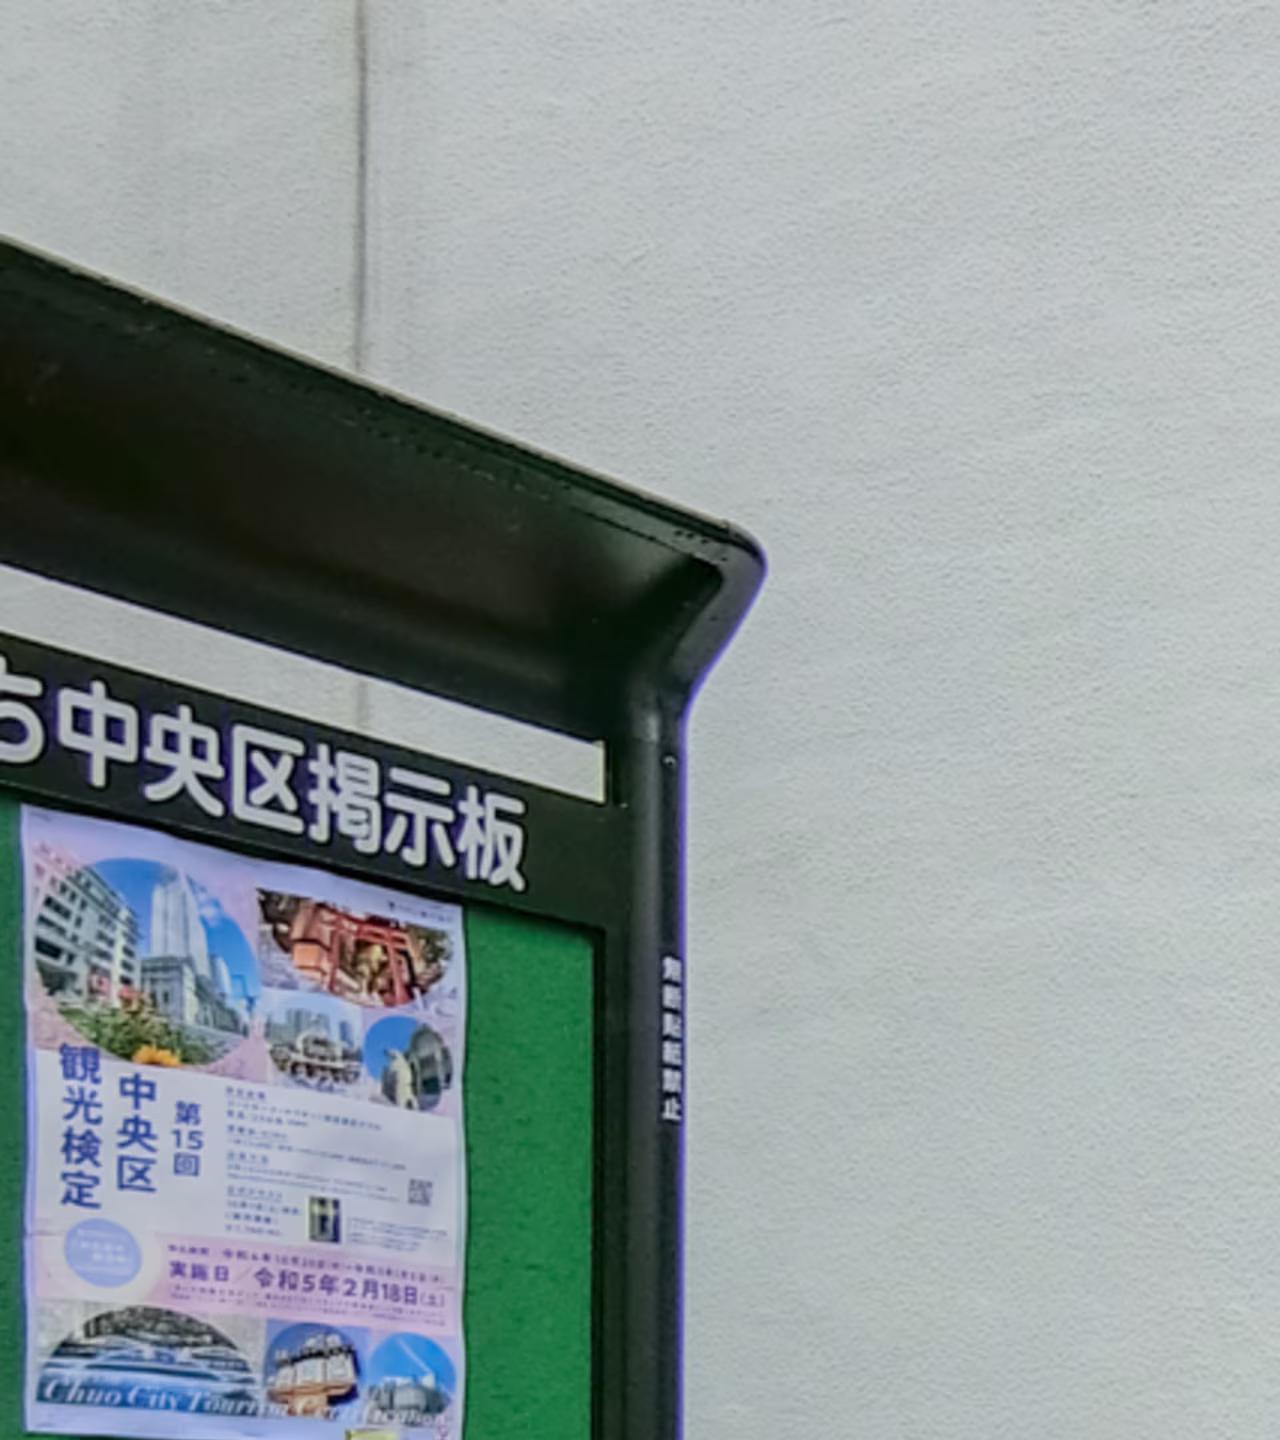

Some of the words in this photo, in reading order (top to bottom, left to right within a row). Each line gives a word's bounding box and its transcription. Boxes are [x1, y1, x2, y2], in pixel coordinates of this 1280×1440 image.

[59, 1042, 103, 1209] 観光検定
[116, 1072, 159, 1193] 中央区
[171, 1100, 204, 1177] 第15回
[44, 1378, 121, 1405] Chuo
